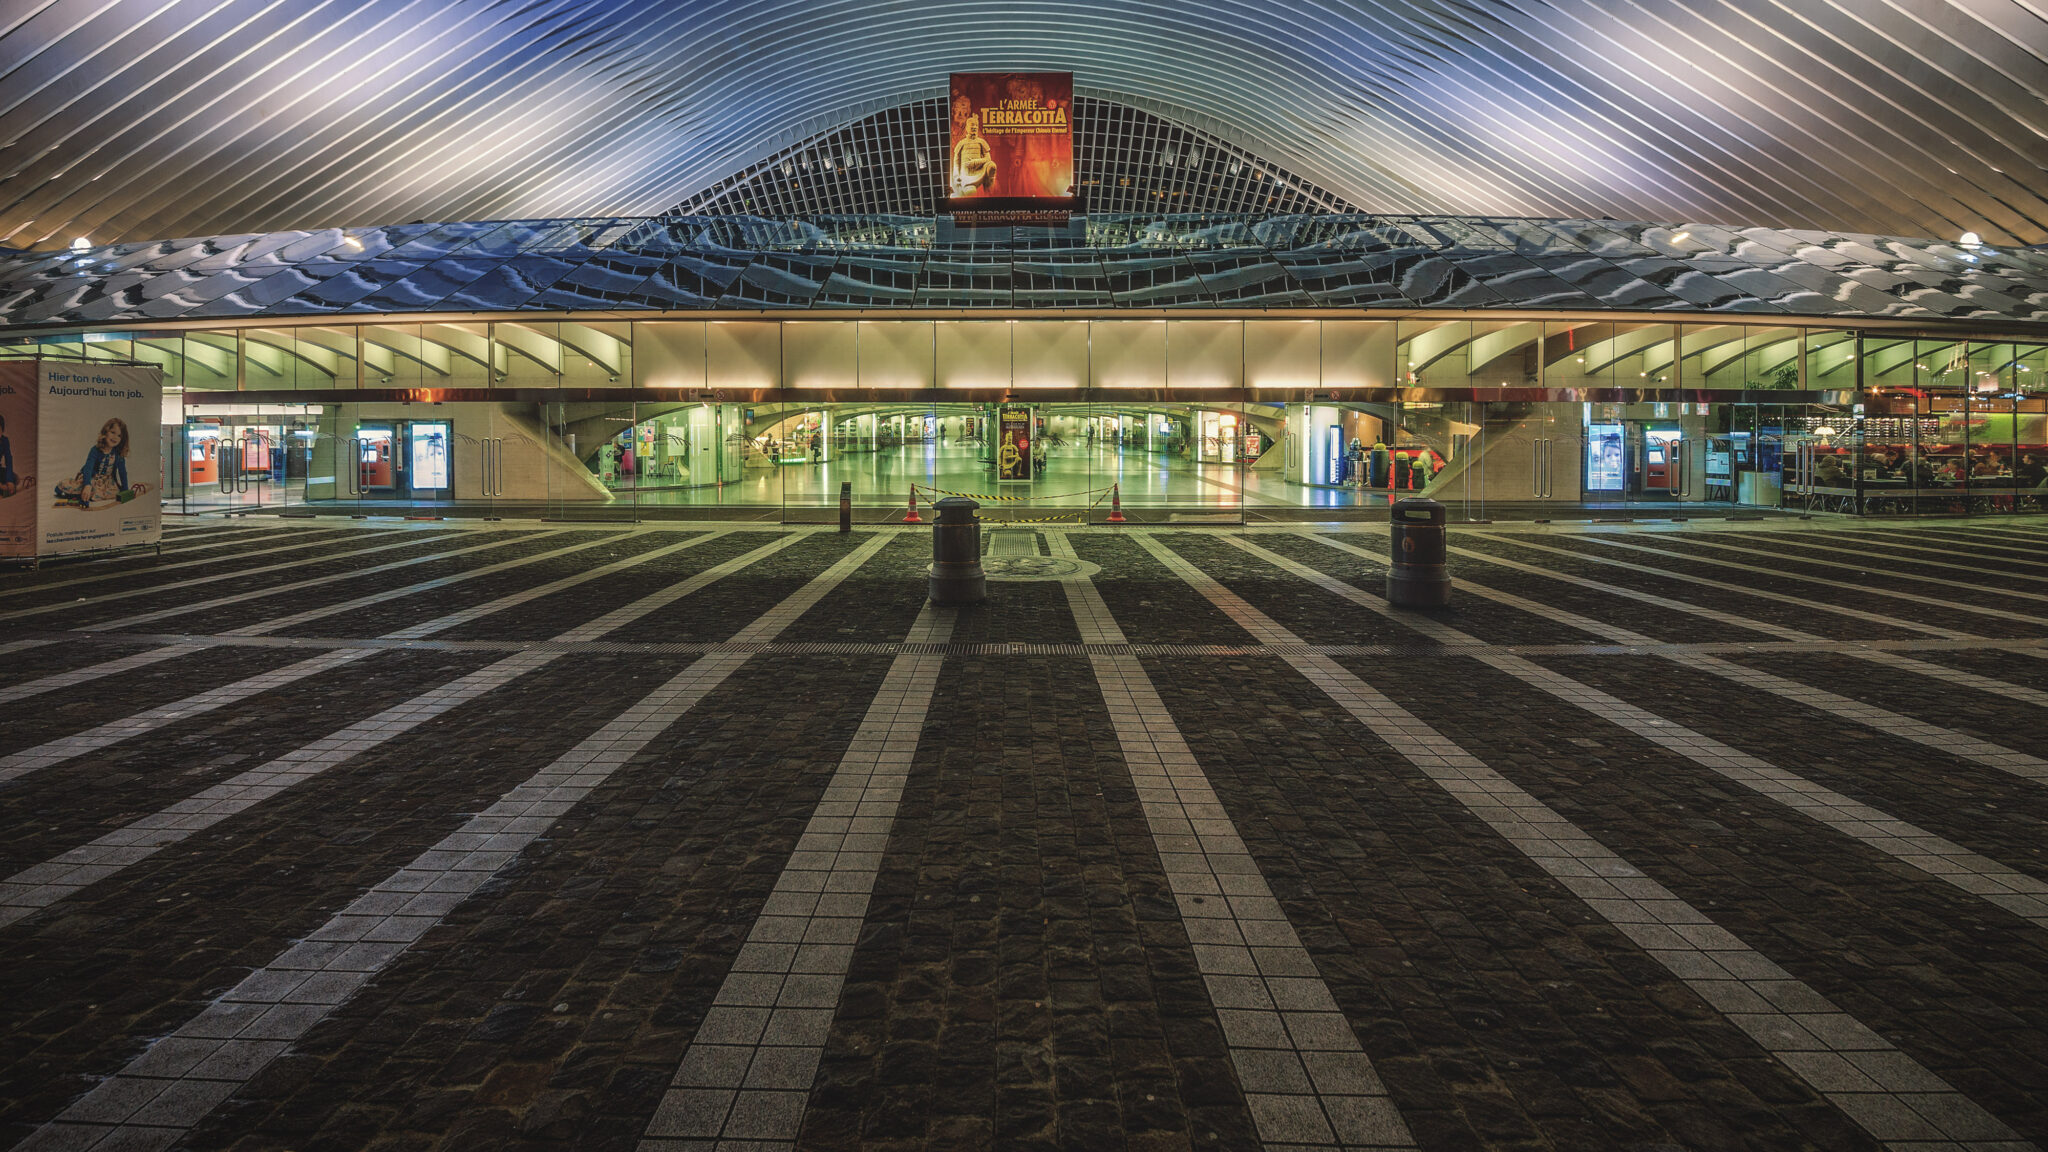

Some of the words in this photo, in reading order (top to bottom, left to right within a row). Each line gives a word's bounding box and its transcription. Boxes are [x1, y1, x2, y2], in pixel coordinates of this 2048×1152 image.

[1000, 98, 1038, 110] L'ARMÉE
[981, 107, 1067, 124] TERRACOTTA
[48, 371, 70, 382] Hier
[72, 374, 89, 383] ton
[91, 374, 115, 385] rêve.
[49, 385, 107, 397] Aujourd'hui
[110, 388, 125, 398] ton
[126, 388, 145, 400] job.
